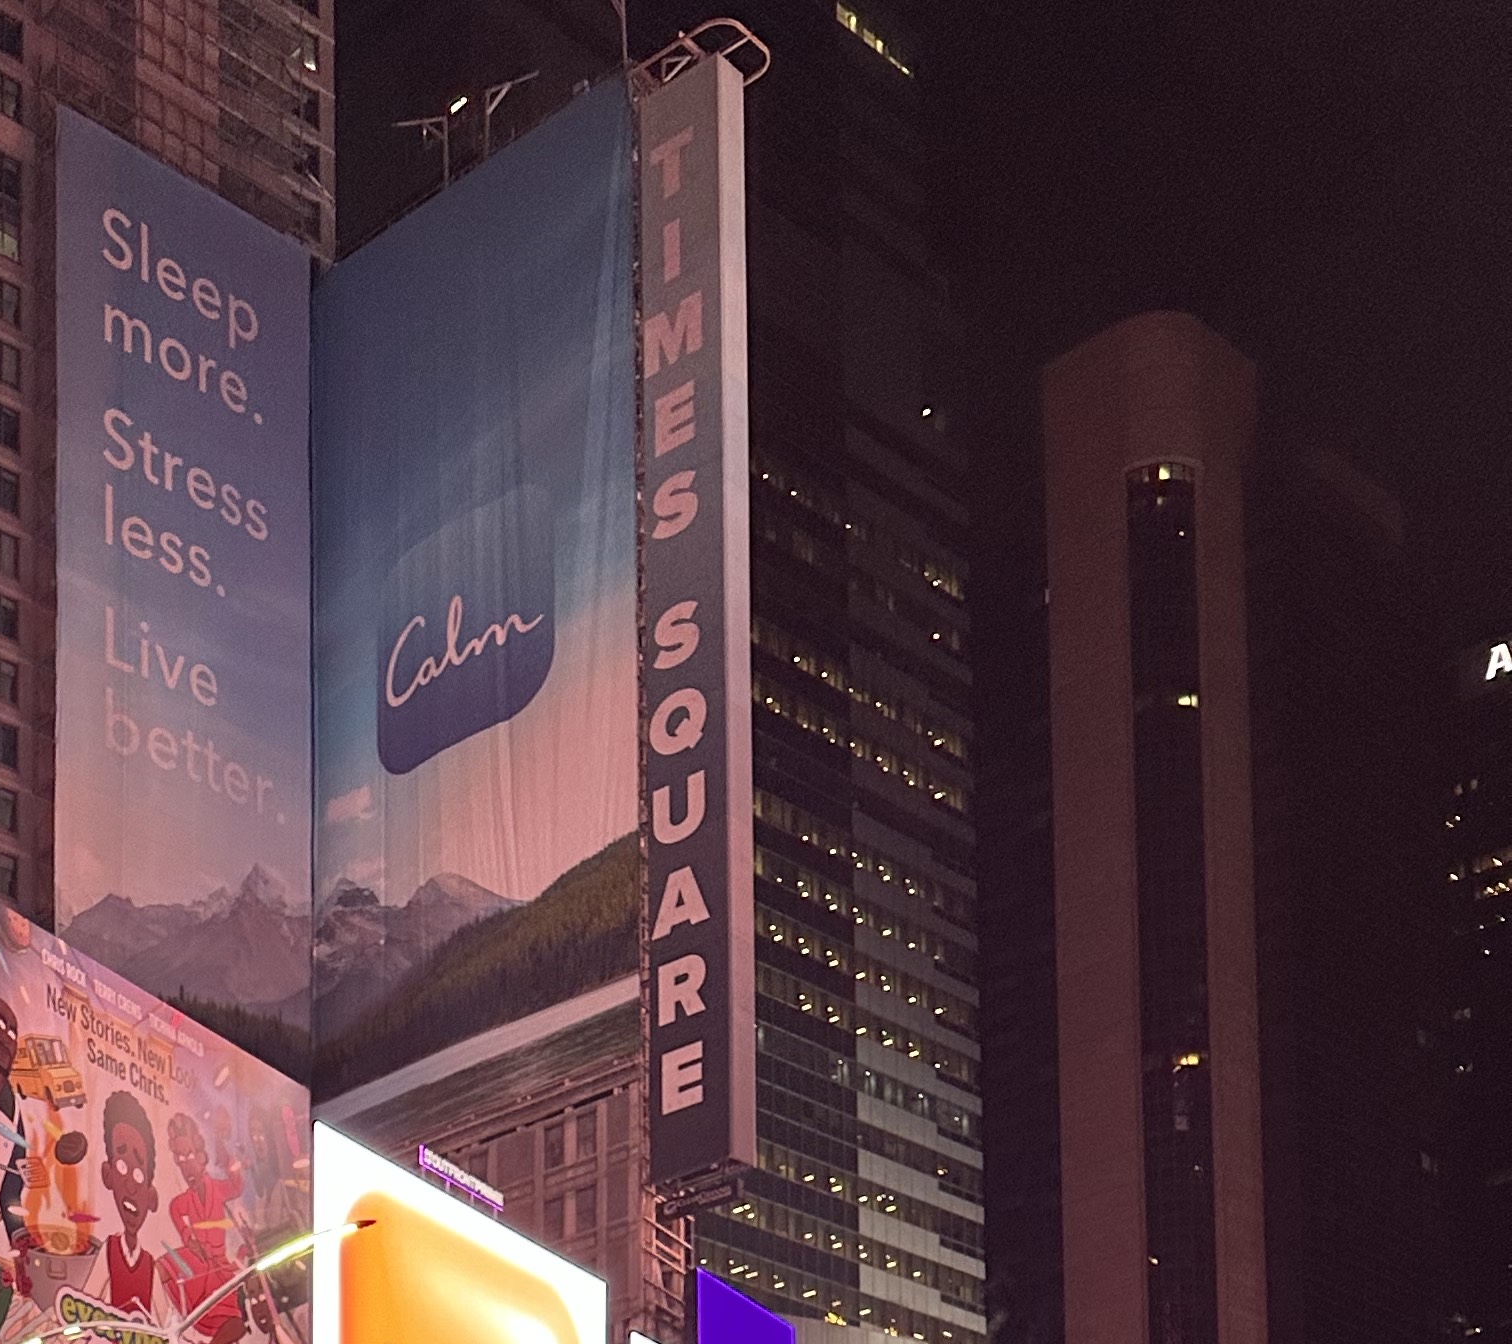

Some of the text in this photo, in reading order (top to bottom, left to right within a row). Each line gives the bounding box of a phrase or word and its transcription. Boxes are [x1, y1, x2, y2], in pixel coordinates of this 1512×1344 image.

[102, 208, 259, 344] Sleep
[644, 127, 703, 540] TIMES
[103, 303, 263, 426] more.
[102, 408, 269, 541] Stress
[103, 487, 226, 597] less.
[104, 608, 219, 706] Live
[387, 595, 544, 707] Calm
[104, 688, 286, 826] better.
[648, 600, 711, 1116] SQUARE
[46, 984, 76, 1023] New
[80, 1003, 135, 1057] Stories.
[138, 1037, 166, 1075] New
[87, 1038, 169, 1105] Same Chris.
